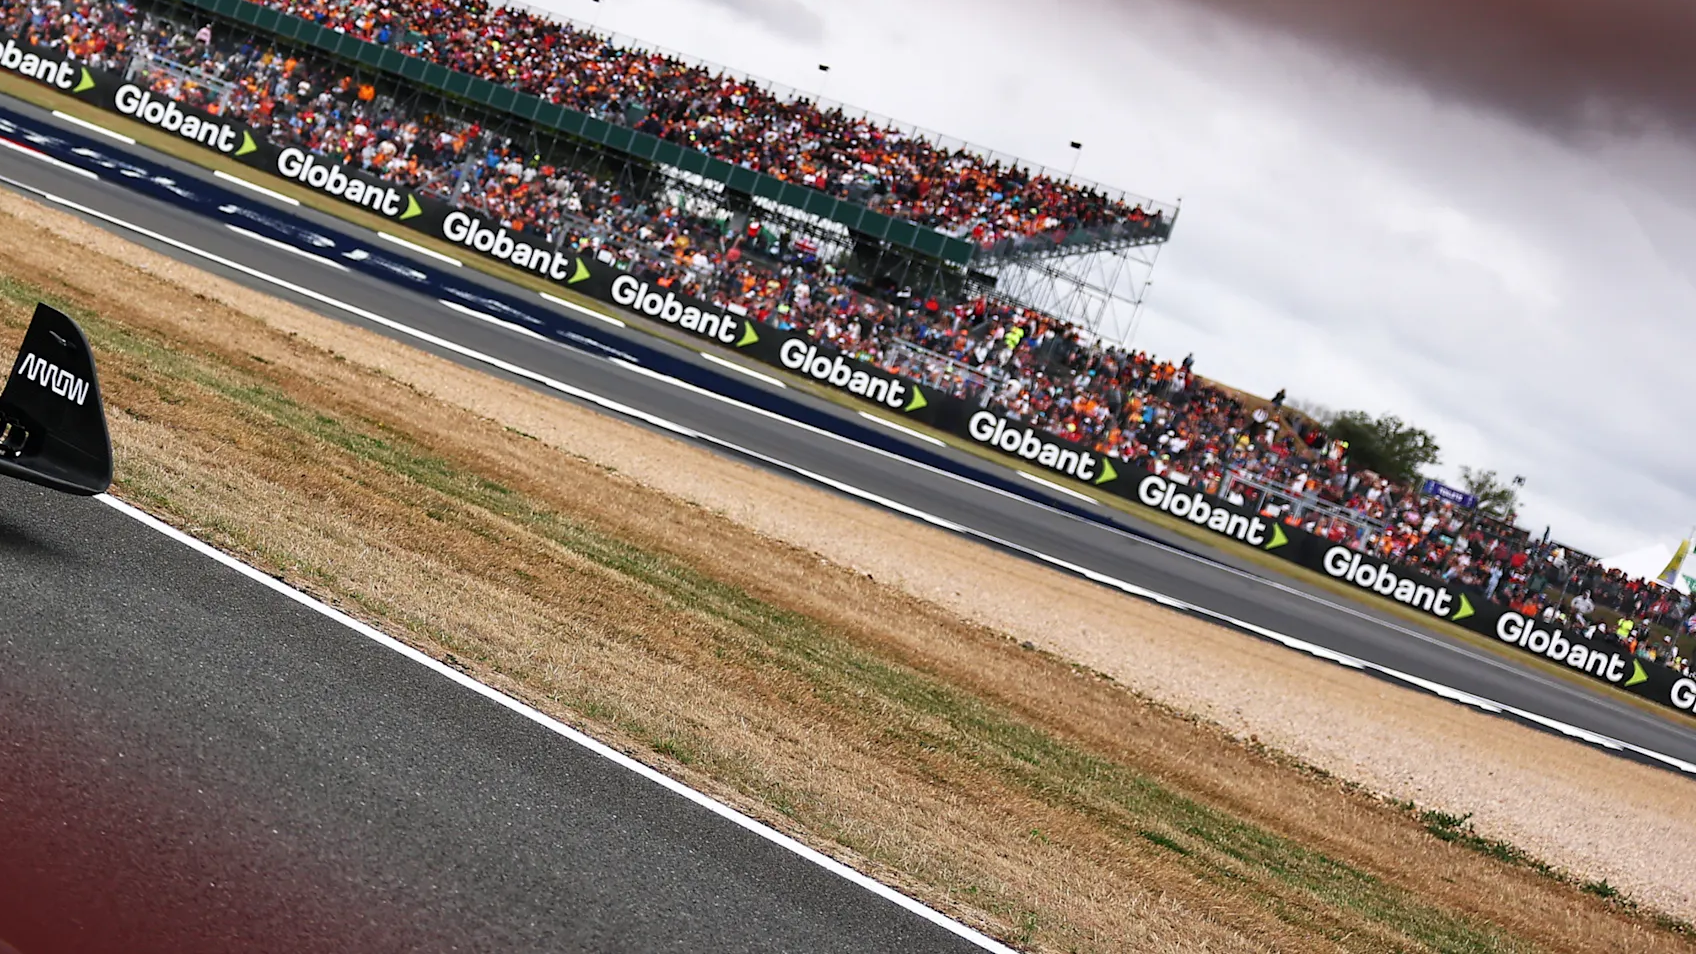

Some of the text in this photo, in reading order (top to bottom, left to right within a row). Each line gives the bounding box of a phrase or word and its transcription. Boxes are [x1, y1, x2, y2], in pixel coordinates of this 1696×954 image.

[114, 83, 236, 155] Globant
[277, 147, 402, 218] Globant
[442, 211, 569, 282] Globant
[610, 274, 737, 344] Globant
[779, 338, 906, 409] Globant
[968, 410, 1096, 480] Globant
[1138, 474, 1266, 546] Globant
[1323, 545, 1453, 619] Globant
[1496, 611, 1625, 685] Globant
